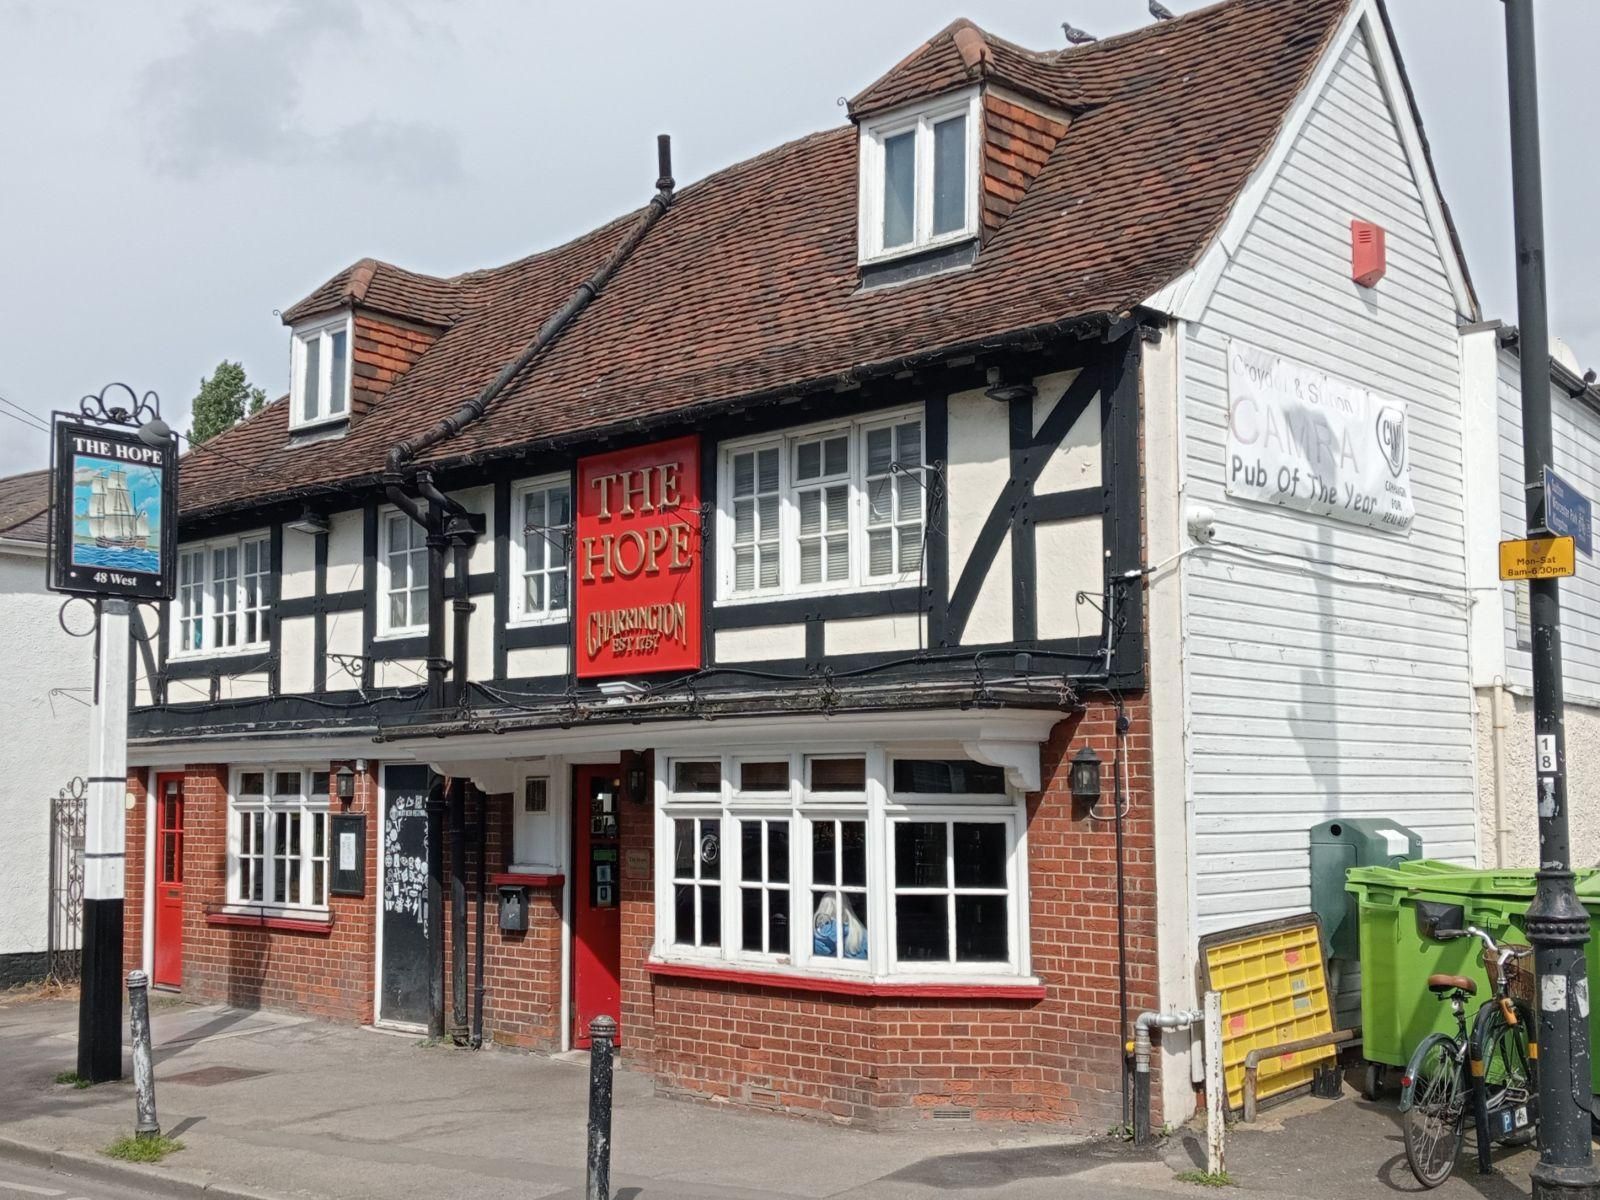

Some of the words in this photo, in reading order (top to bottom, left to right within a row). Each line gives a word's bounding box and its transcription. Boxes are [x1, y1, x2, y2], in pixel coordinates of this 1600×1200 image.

[72, 437, 112, 456] THE
[116, 444, 162, 464] HOPE
[1230, 395, 1361, 474] CAMRA
[591, 461, 681, 519] THE
[1232, 454, 1268, 488] Pub
[1277, 465, 1300, 497] Of
[1307, 472, 1338, 505] The
[1345, 482, 1377, 514] Year
[94, 572, 108, 584] 48
[110, 573, 137, 586] West
[581, 522, 693, 581] HOPE
[1516, 556, 1557, 566] Mon-Sat
[586, 602, 686, 657] CHARRINGTON
